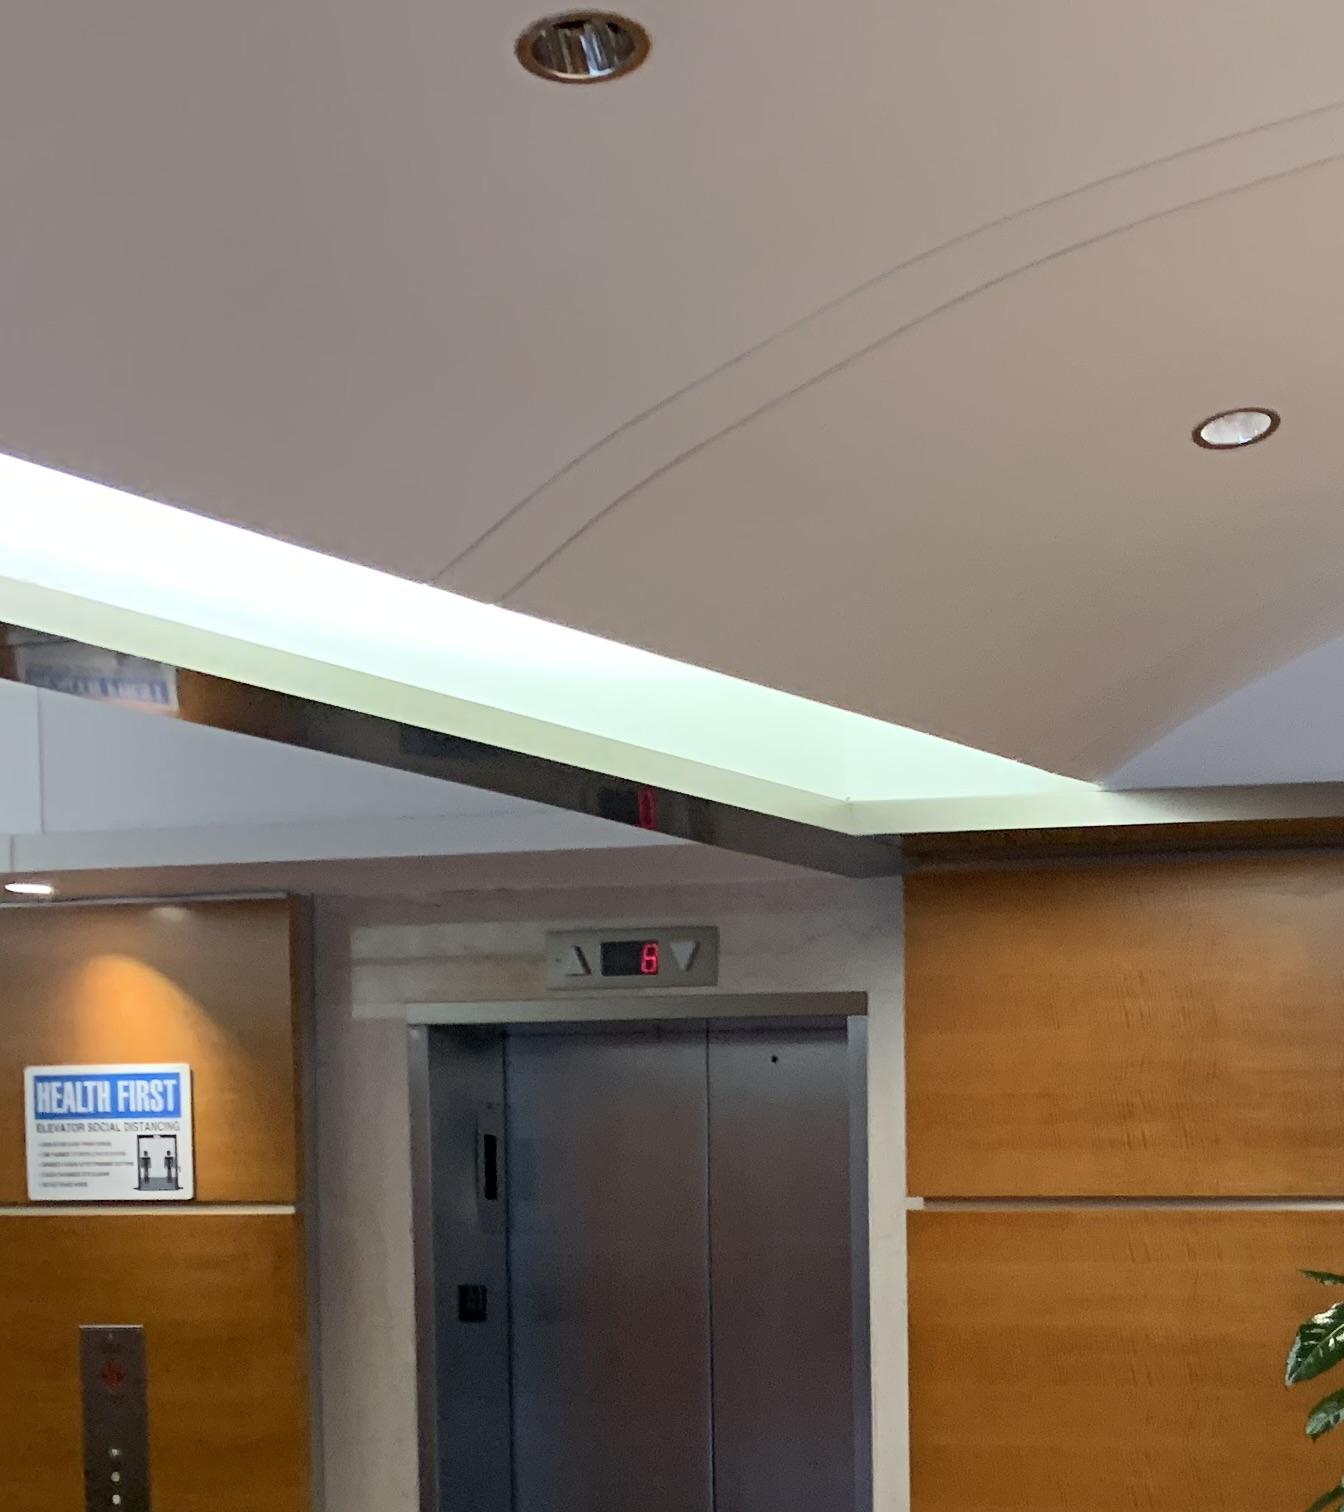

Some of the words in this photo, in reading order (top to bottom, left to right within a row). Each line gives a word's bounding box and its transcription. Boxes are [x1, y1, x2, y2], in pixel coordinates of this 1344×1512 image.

[36, 1080, 111, 1113] HEALTH
[117, 1079, 177, 1112] FIRST
[36, 1122, 85, 1133] ELEVATOR
[88, 1122, 120, 1132] SOCIAL
[124, 1121, 180, 1132] DISTANCING
